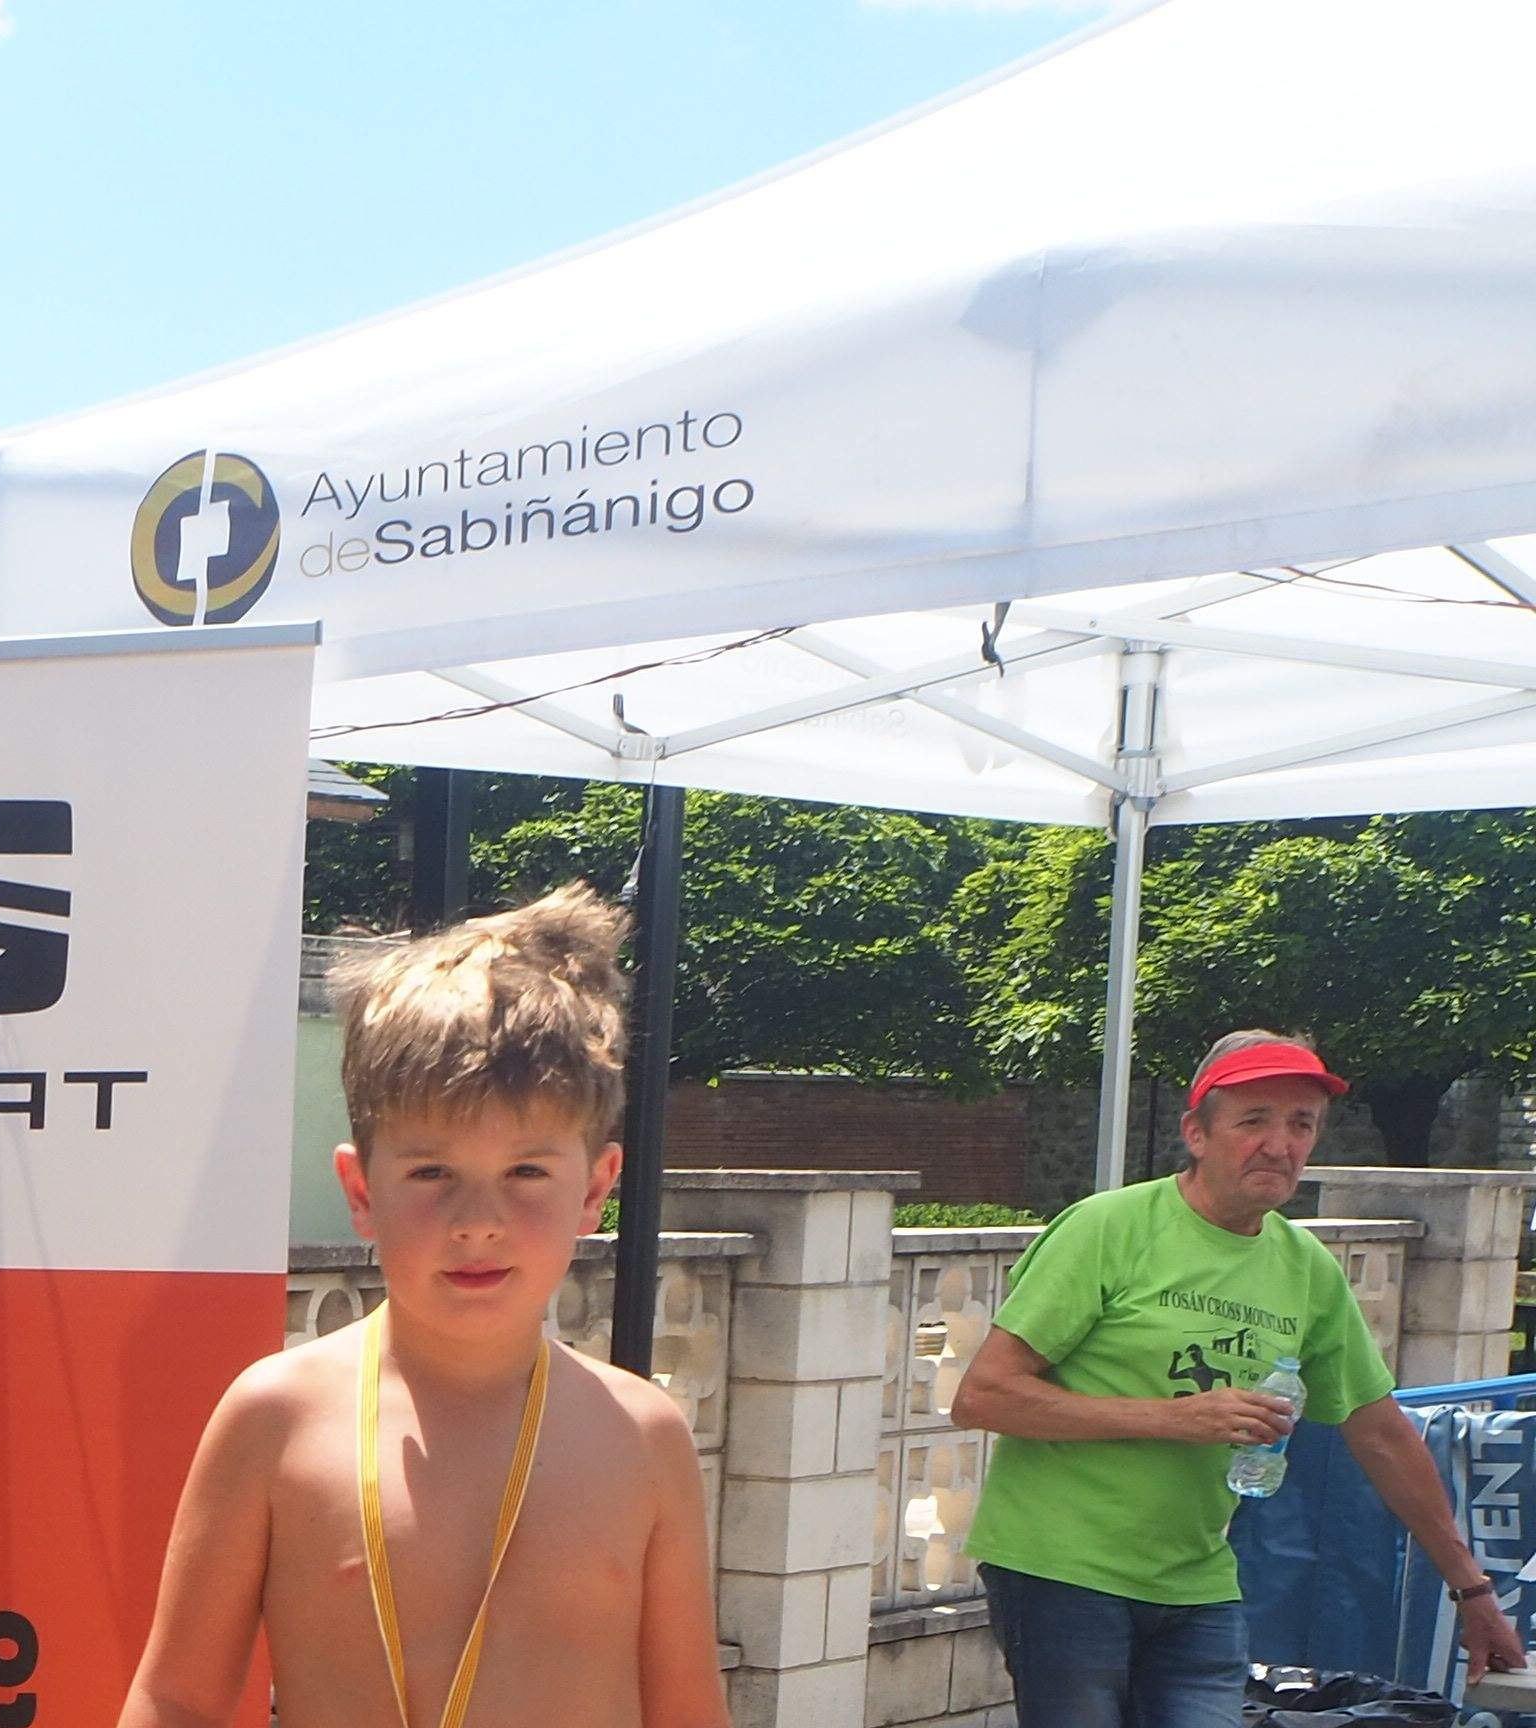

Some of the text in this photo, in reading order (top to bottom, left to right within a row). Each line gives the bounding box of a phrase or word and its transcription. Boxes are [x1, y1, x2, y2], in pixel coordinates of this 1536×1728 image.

[300, 408, 744, 519] Ayuntamiento
[1207, 1296, 1242, 1323] CROSS
[1242, 1304, 1298, 1335] MOUNTAIN
